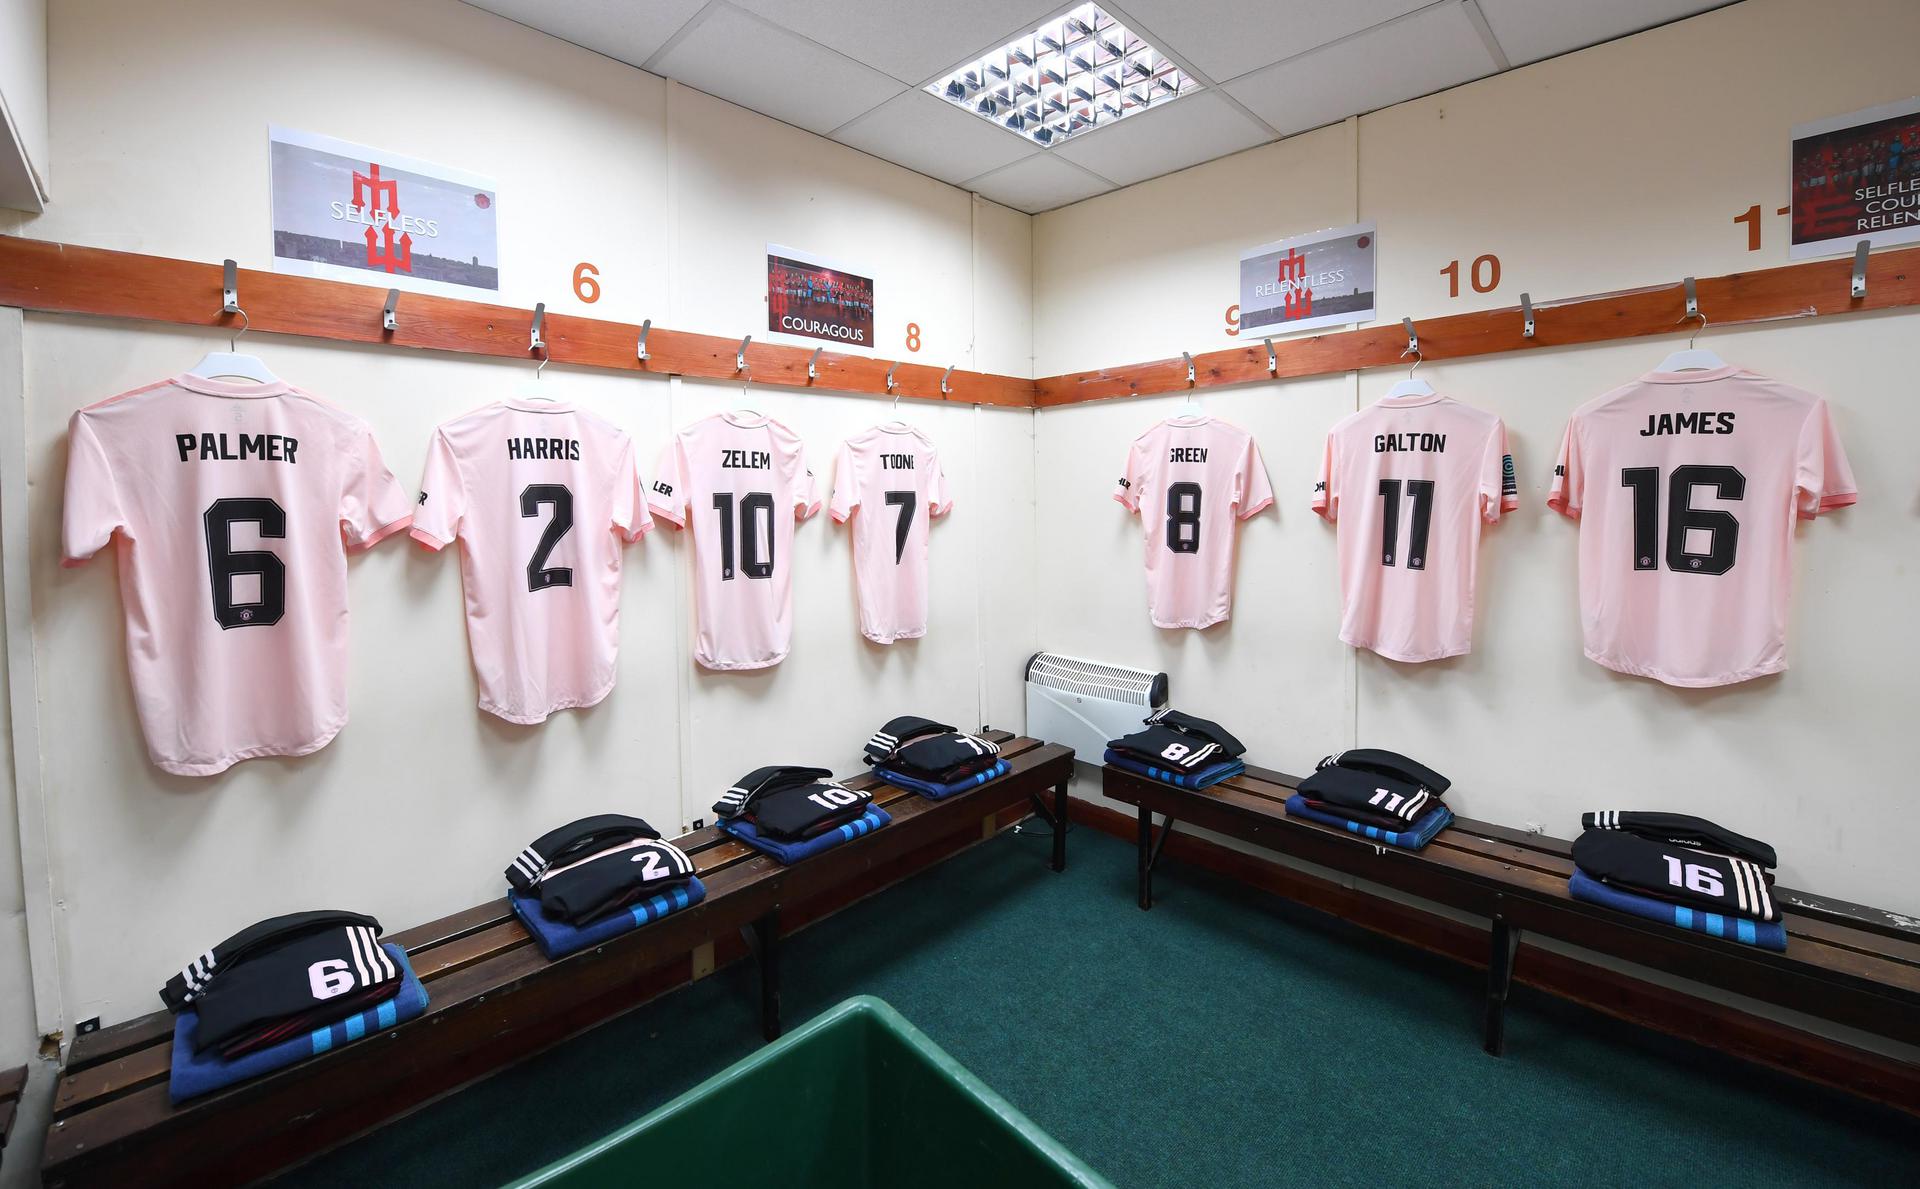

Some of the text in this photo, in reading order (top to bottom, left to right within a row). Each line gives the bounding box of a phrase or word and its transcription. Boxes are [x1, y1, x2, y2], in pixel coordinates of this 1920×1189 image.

[330, 200, 440, 238] SELFLESS
[573, 262, 600, 304] 6
[1255, 269, 1345, 299] RELENTLESS
[1440, 254, 1501, 298] 10
[782, 316, 864, 341] COURAGOUS
[905, 322, 921, 352] 8
[1639, 411, 1736, 437] JAMES
[176, 432, 299, 464] PALMER
[507, 437, 580, 461] HARRIS
[1374, 432, 1447, 454] GALTON
[722, 450, 770, 469] ZELEM
[653, 480, 673, 497] LER
[885, 490, 917, 565] 7
[1166, 481, 1202, 554] 8
[1378, 478, 1435, 571] 11
[1621, 464, 1747, 576] 16
[519, 483, 574, 593] 2
[713, 492, 775, 581] 10
[204, 497, 287, 631] 6
[954, 736, 983, 756] 7
[1161, 743, 1190, 761] 8
[807, 788, 858, 811] 10
[1368, 788, 1405, 812] 11
[630, 851, 670, 882] 2
[1662, 854, 1725, 897] 16
[307, 958, 356, 1000] 6
